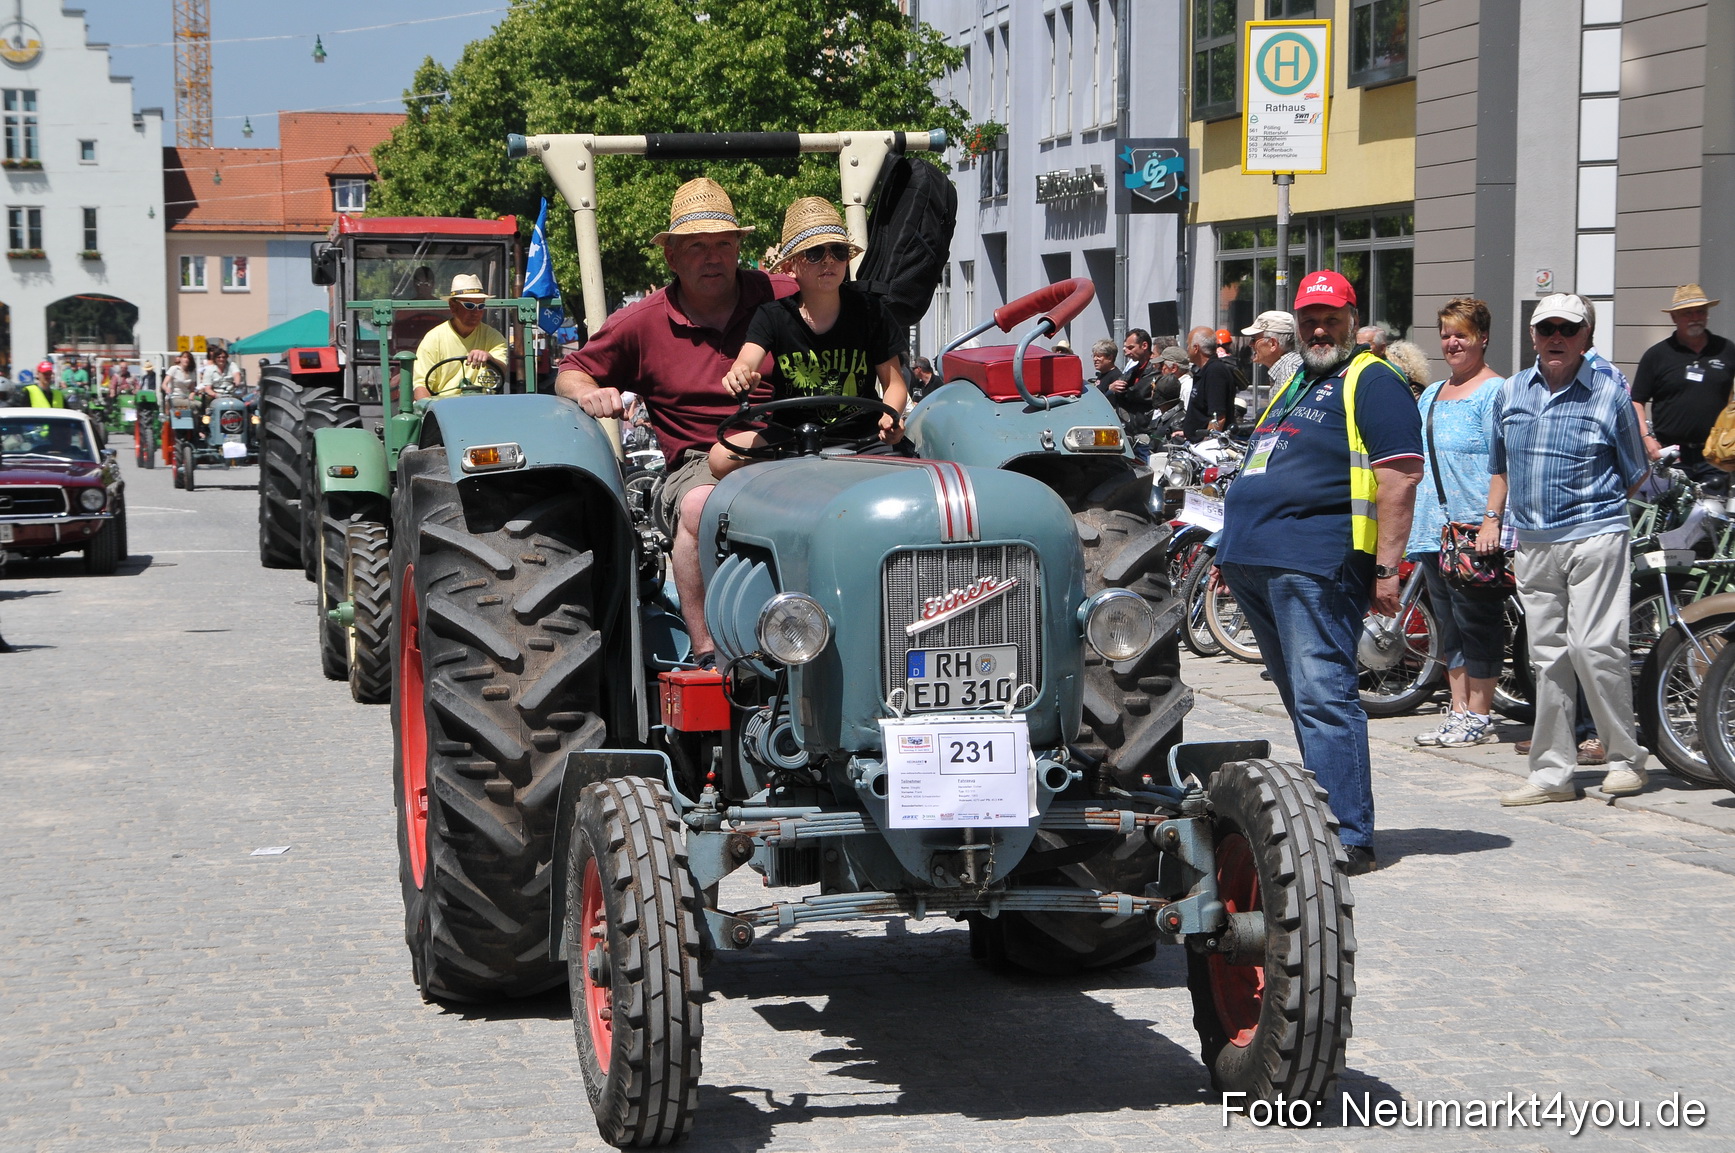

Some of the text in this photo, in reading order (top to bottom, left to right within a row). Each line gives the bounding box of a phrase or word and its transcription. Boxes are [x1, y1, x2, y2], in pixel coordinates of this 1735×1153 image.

[1274, 46, 1299, 81] H
[1265, 103, 1306, 112] Rathaus
[1142, 158, 1168, 189] G2
[1306, 284, 1334, 294] DEKRA
[777, 349, 868, 378] BRASILIA
[1315, 388, 1334, 397] CREW
[1290, 406, 1327, 424] TEAM
[923, 576, 998, 619] Eicher
[912, 667, 920, 677] D
[936, 652, 972, 679] RH
[915, 677, 1012, 709] ED 310
[950, 740, 995, 764] 231
